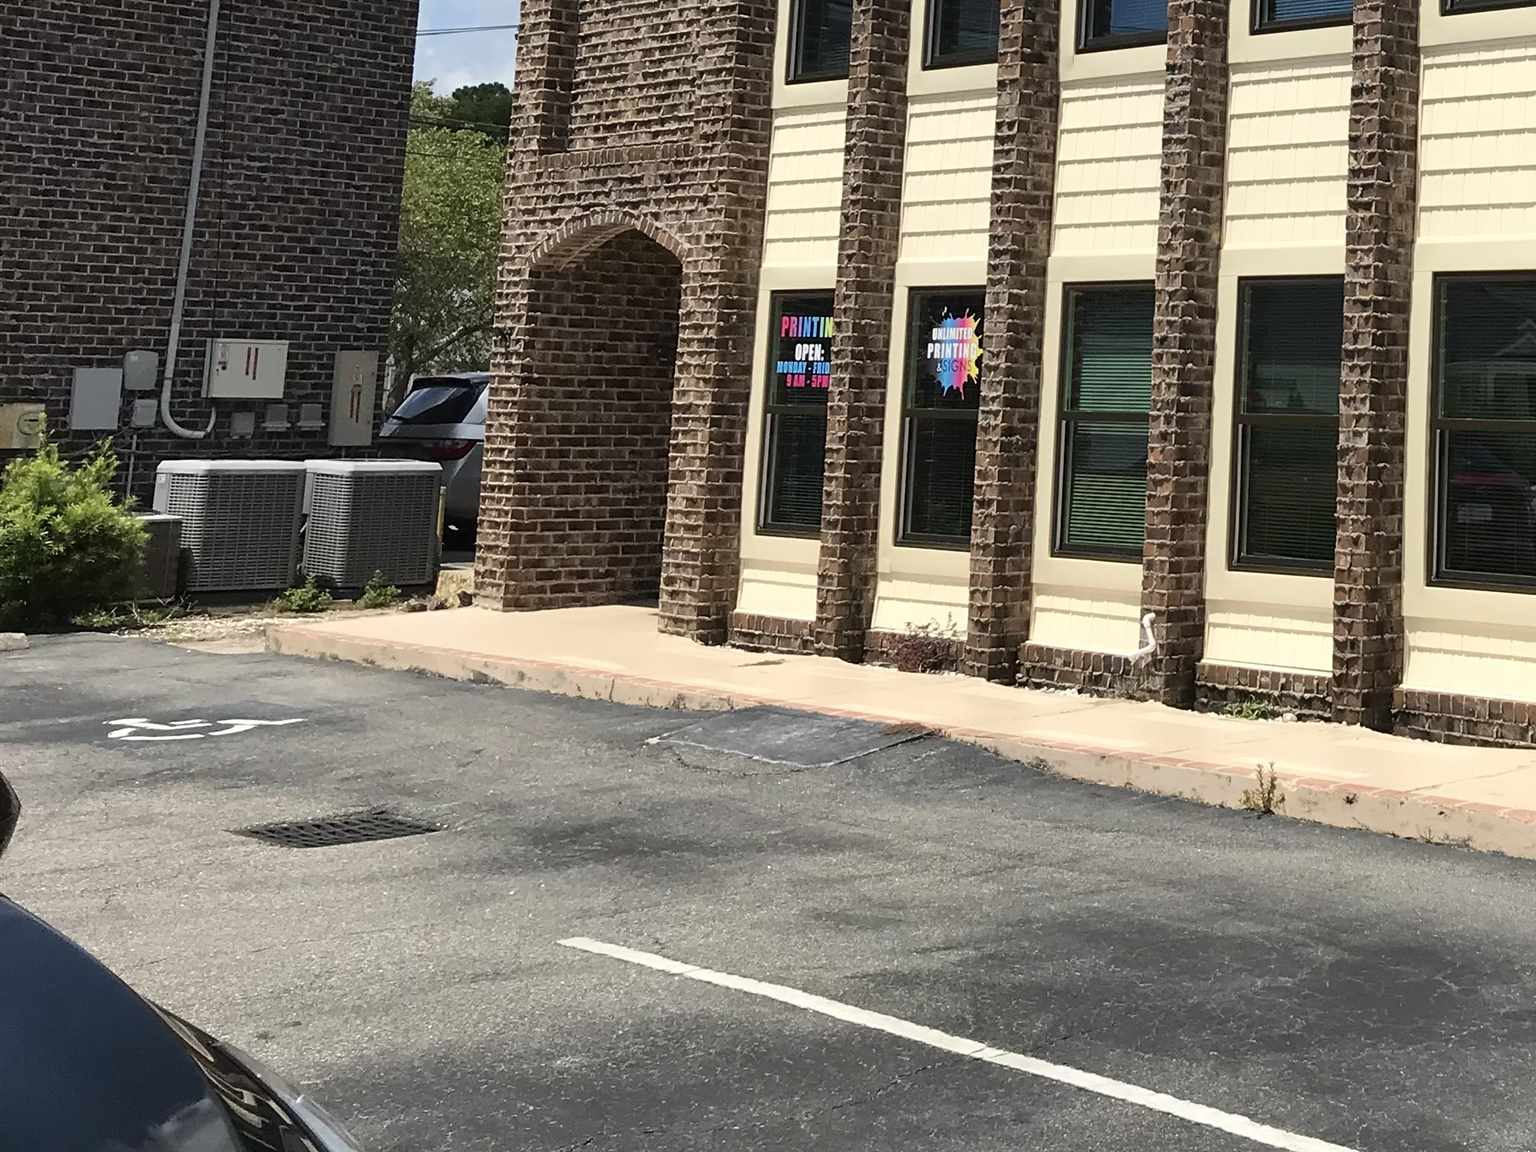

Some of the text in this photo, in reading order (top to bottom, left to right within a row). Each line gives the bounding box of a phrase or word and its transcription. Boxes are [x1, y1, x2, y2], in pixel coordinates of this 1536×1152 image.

[932, 327, 974, 341] UNLIMITED
[795, 343, 825, 361] OPEN:
[927, 342, 977, 359] PRINTING
[776, 361, 807, 374] MONDAY
